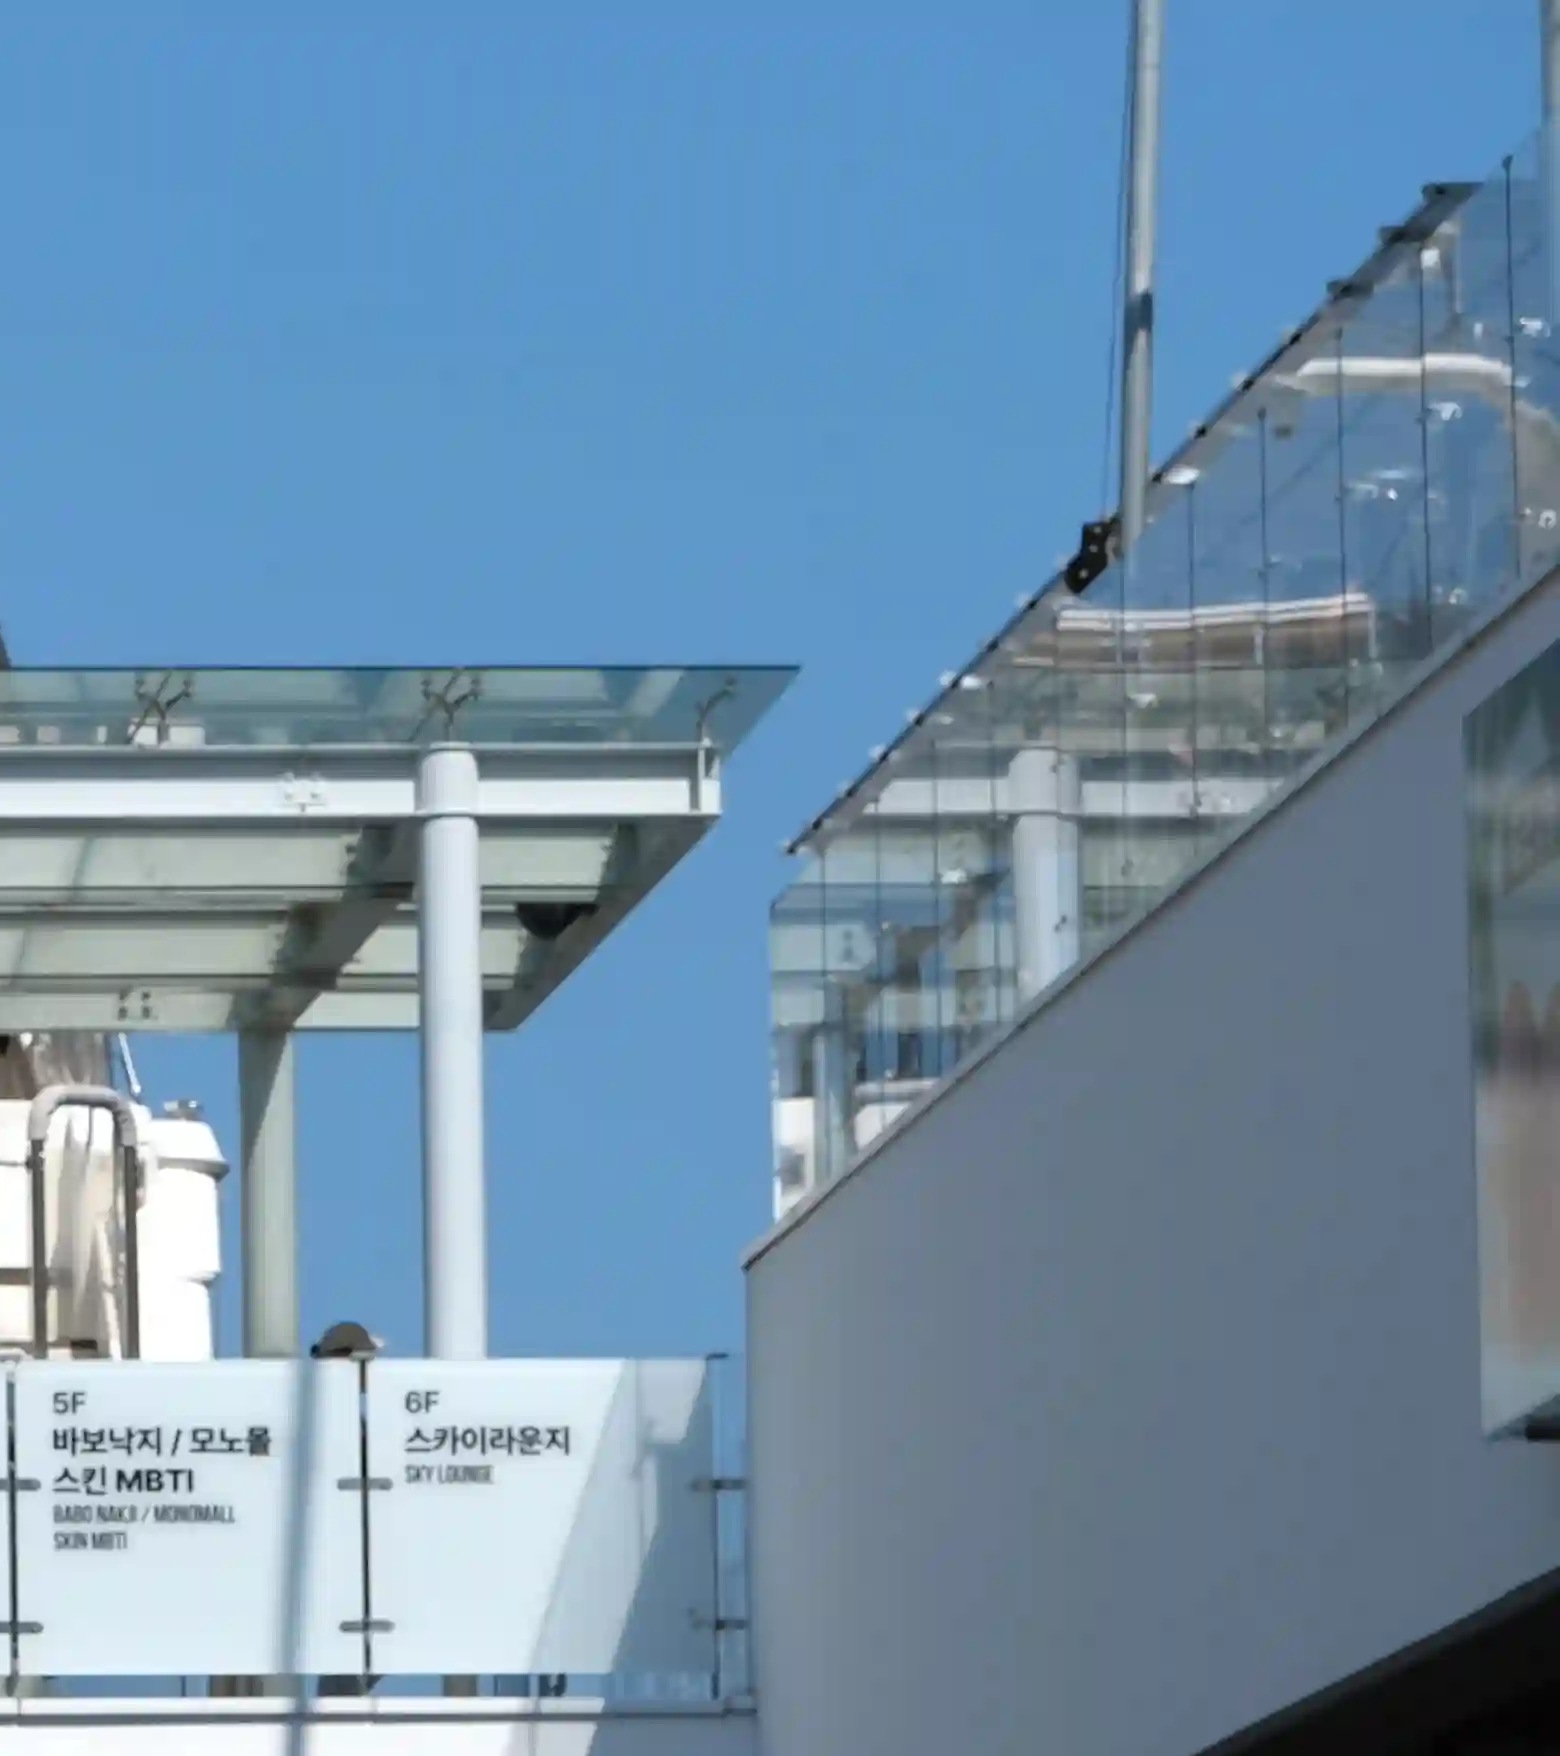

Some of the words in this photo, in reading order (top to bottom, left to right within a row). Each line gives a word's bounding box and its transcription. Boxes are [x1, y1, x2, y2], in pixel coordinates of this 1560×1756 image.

[53, 1392, 85, 1415] 5F
[405, 1391, 439, 1414] 6F
[53, 1427, 161, 1457] 바보낙지
[405, 1426, 570, 1456] 스카이라운지
[53, 1465, 107, 1496] 스킨
[116, 1469, 193, 1492] MBTI
[405, 1464, 434, 1484] SKY
[438, 1465, 492, 1484] LOUNGE
